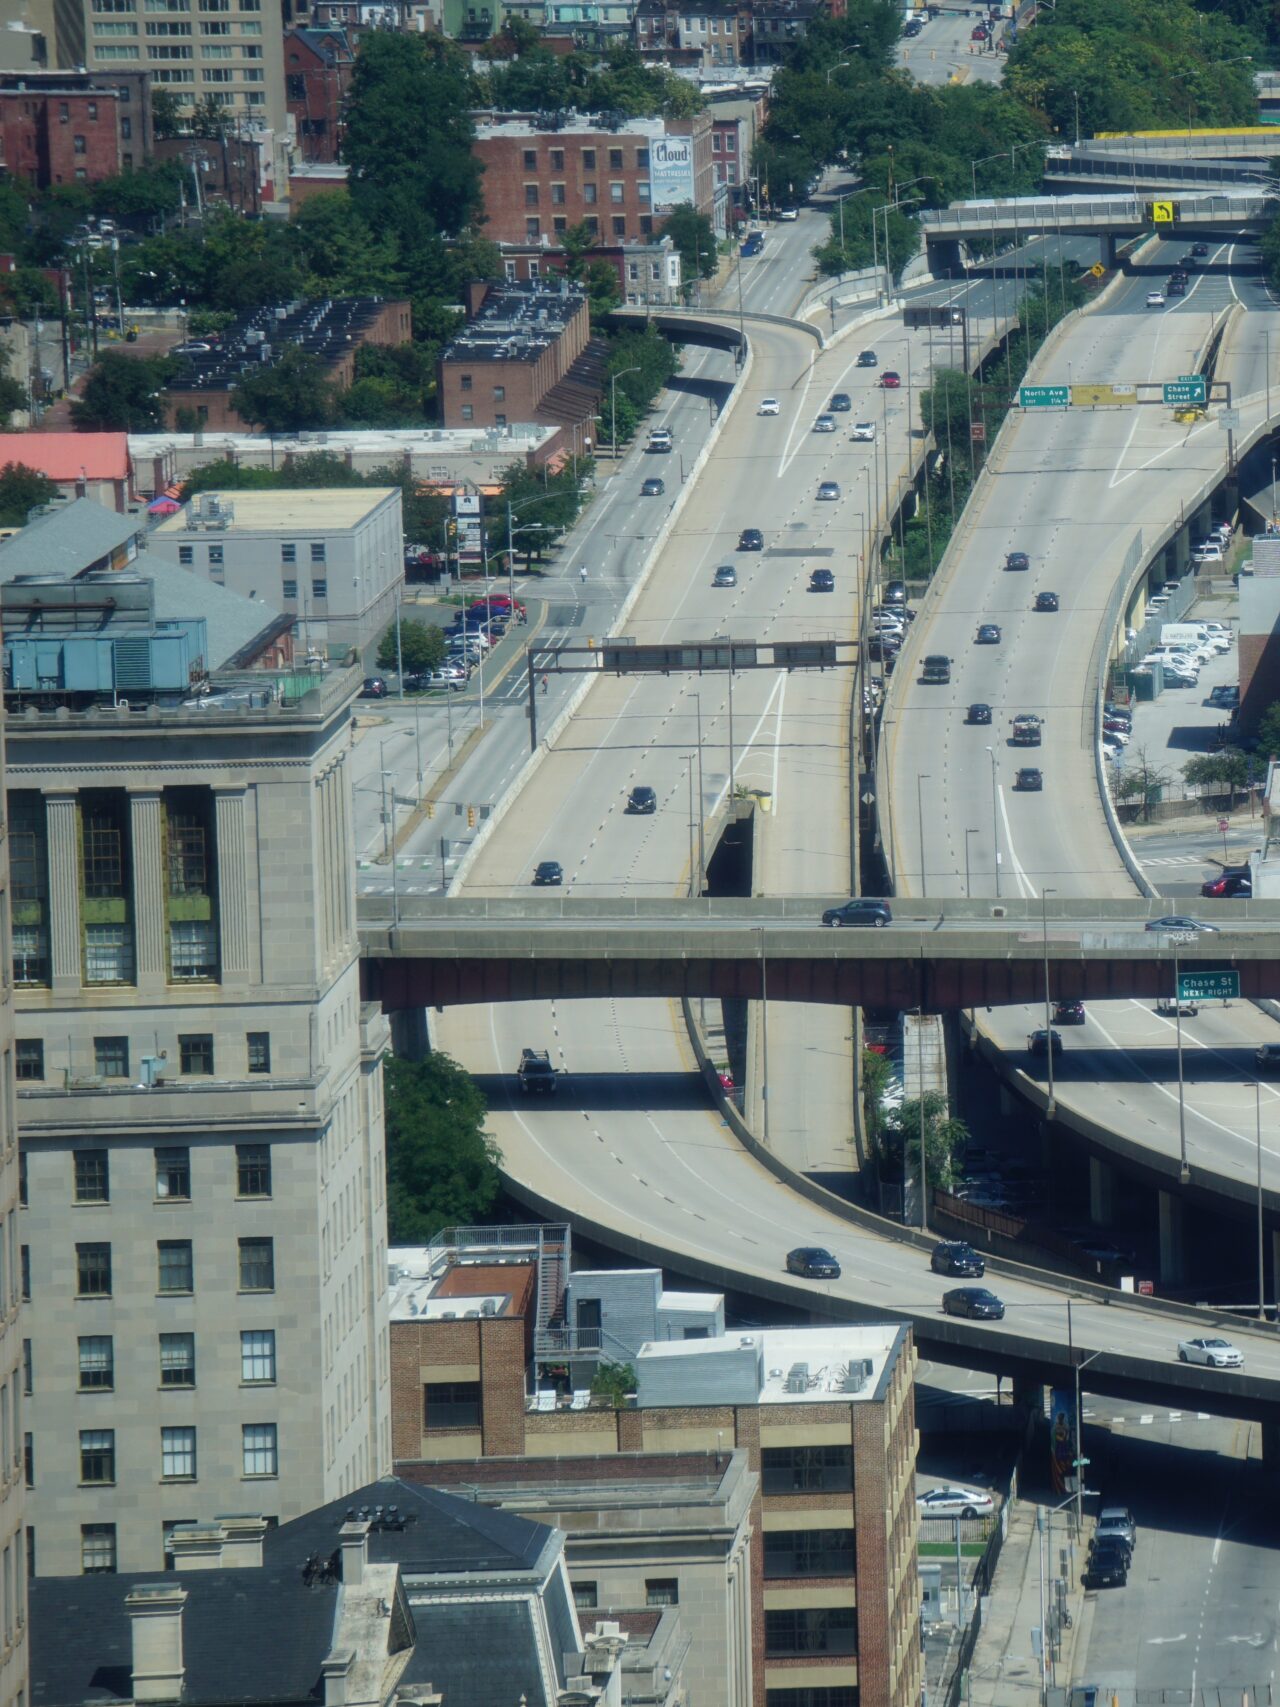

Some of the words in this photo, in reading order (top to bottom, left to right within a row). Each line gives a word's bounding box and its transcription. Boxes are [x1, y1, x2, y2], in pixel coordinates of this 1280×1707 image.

[657, 144, 688, 162] Cloud
[1183, 979, 1215, 987] Chase
[1221, 977, 1232, 985] St
